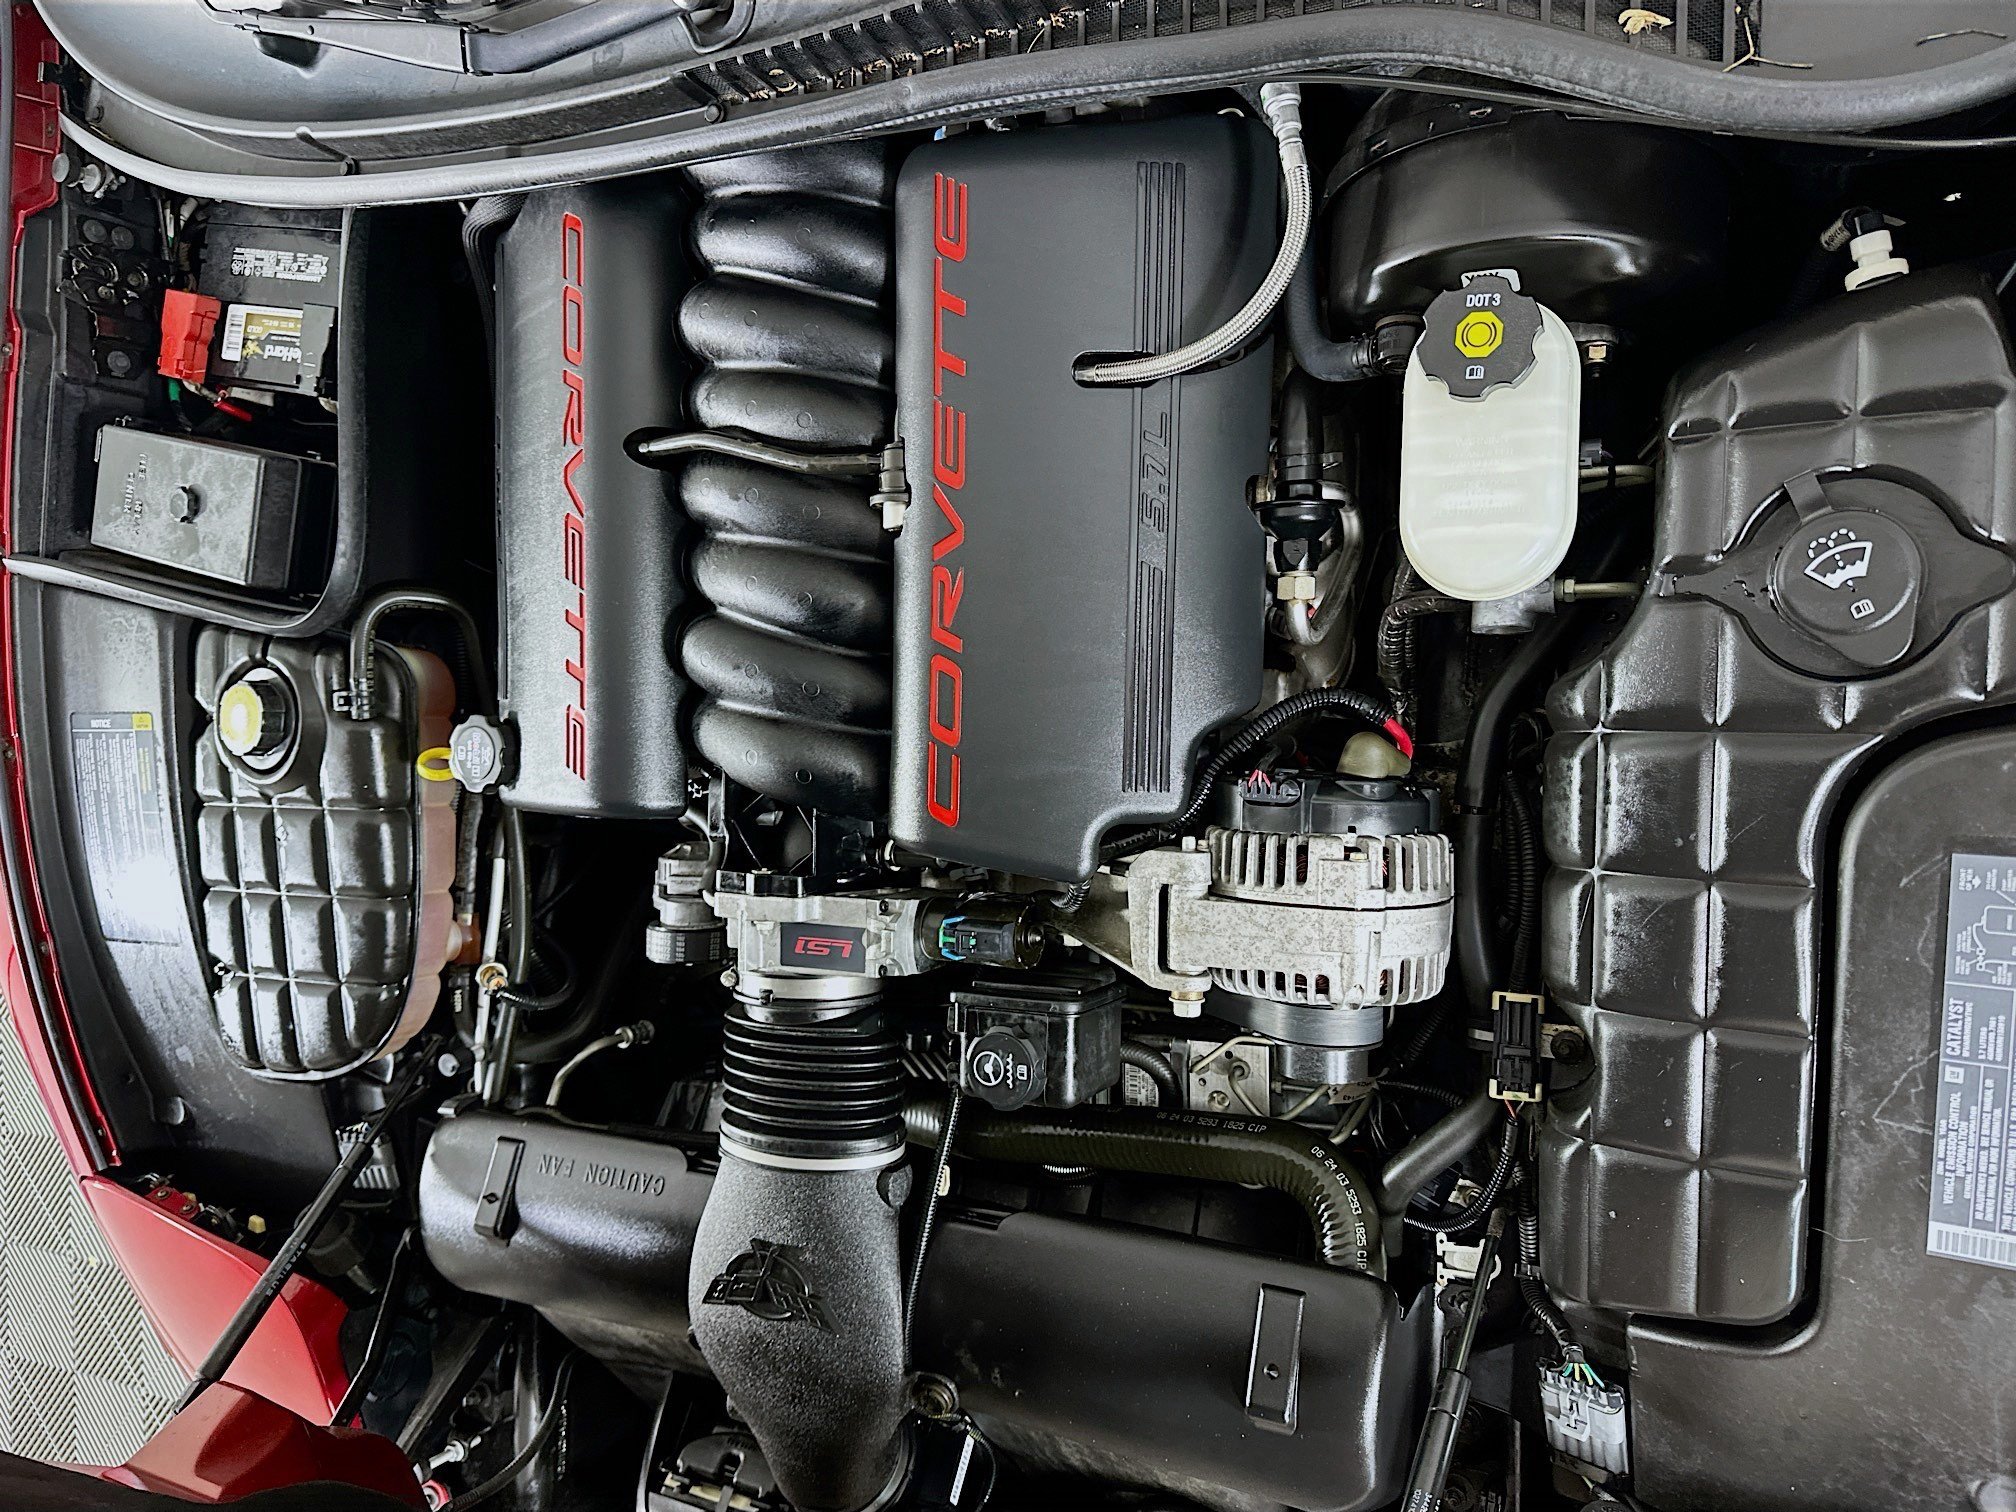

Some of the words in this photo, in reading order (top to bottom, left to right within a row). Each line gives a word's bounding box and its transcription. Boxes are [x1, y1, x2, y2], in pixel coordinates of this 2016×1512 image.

[1466, 294, 1492, 307] DOT
[1492, 293, 1501, 306] 3
[263, 345, 302, 363] ieHard
[1142, 411, 1168, 533] 5.7L
[561, 211, 586, 780] CORVETTE
[928, 172, 968, 827] CORVETTE
[91, 719, 111, 728] NOTICE
[1958, 868, 1967, 890] FRONT
[795, 939, 852, 958] LS1
[1946, 997, 1964, 1056] CATALYST
[1979, 1027, 1988, 1048] LITERS
[1948, 1092, 1961, 1130] CONTROL
[1982, 1089, 1993, 1112] MANUAL
[1169, 1113, 1180, 1121] 24
[1183, 1115, 1195, 1123] 03
[1197, 1118, 1219, 1127] 5293
[1223, 1119, 1246, 1130] 1825
[1248, 1123, 1268, 1133] CIP
[1939, 1120, 1947, 1135] YEAR
[1968, 1106, 1978, 1147] CORPORATION
[1981, 1113, 1992, 1136] SERVICE
[1311, 1146, 1325, 1158] 06
[1938, 1138, 1946, 1158] MODEL
[1946, 1131, 1958, 1170] EMISSION
[1955, 1121, 1968, 1177] INFORMATION
[537, 1155, 575, 1179] FAN
[1324, 1158, 1338, 1171] 24
[1966, 1148, 1975, 1172] MOTORS
[2004, 1148, 2016, 1186] CONFORMS
[584, 1163, 665, 1197] CAUTION
[1336, 1172, 1350, 1187] 03
[1943, 1172, 1956, 1204] VEHICLE
[1964, 1173, 1972, 1199] GENERAL
[1986, 1176, 1997, 1198] MANUAL
[1345, 1189, 1362, 1215] 5293
[2002, 1186, 2014, 1214] VEHICLE
[2001, 1215, 2012, 1230] THIS
[1354, 1222, 1367, 1247] 1825
[1357, 1250, 1368, 1270] CIP
